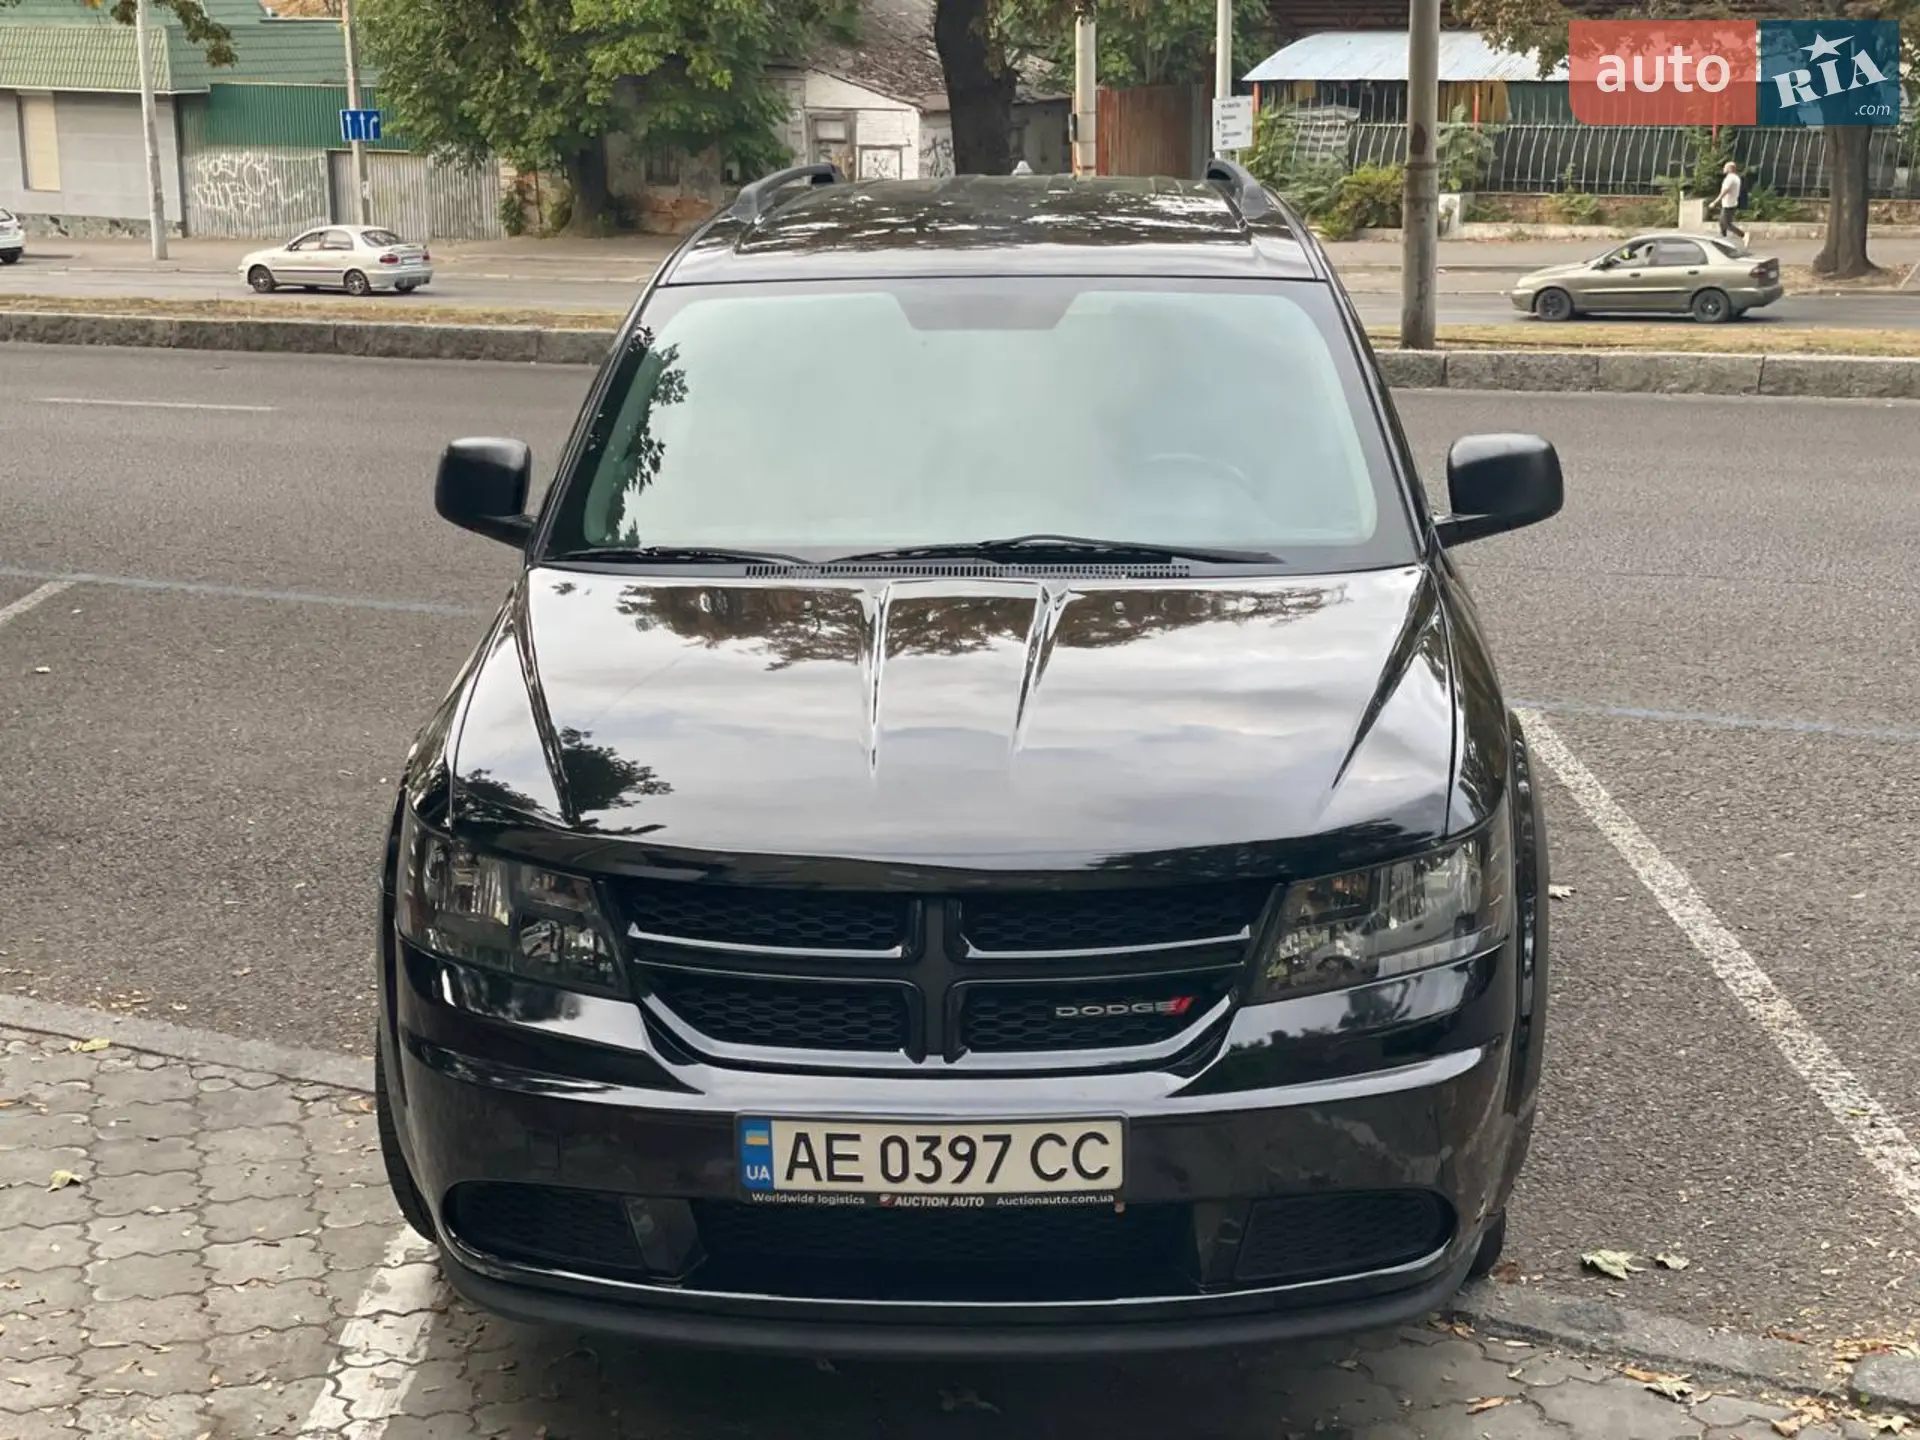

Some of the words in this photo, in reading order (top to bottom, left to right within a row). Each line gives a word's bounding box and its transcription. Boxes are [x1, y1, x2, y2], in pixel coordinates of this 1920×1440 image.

[1056, 1002, 1178, 1016] DODGE
[785, 1132, 864, 1182] AE
[880, 1134, 1012, 1184] 0397
[1029, 1131, 1110, 1182] CC
[746, 1165, 770, 1180] UA
[752, 1192, 814, 1203] Worldwide
[818, 1194, 865, 1205] logistics
[894, 1196, 949, 1207] AUCTION
[950, 1196, 985, 1207] AUTO
[996, 1194, 1114, 1206] Auctionauto.com.ua
